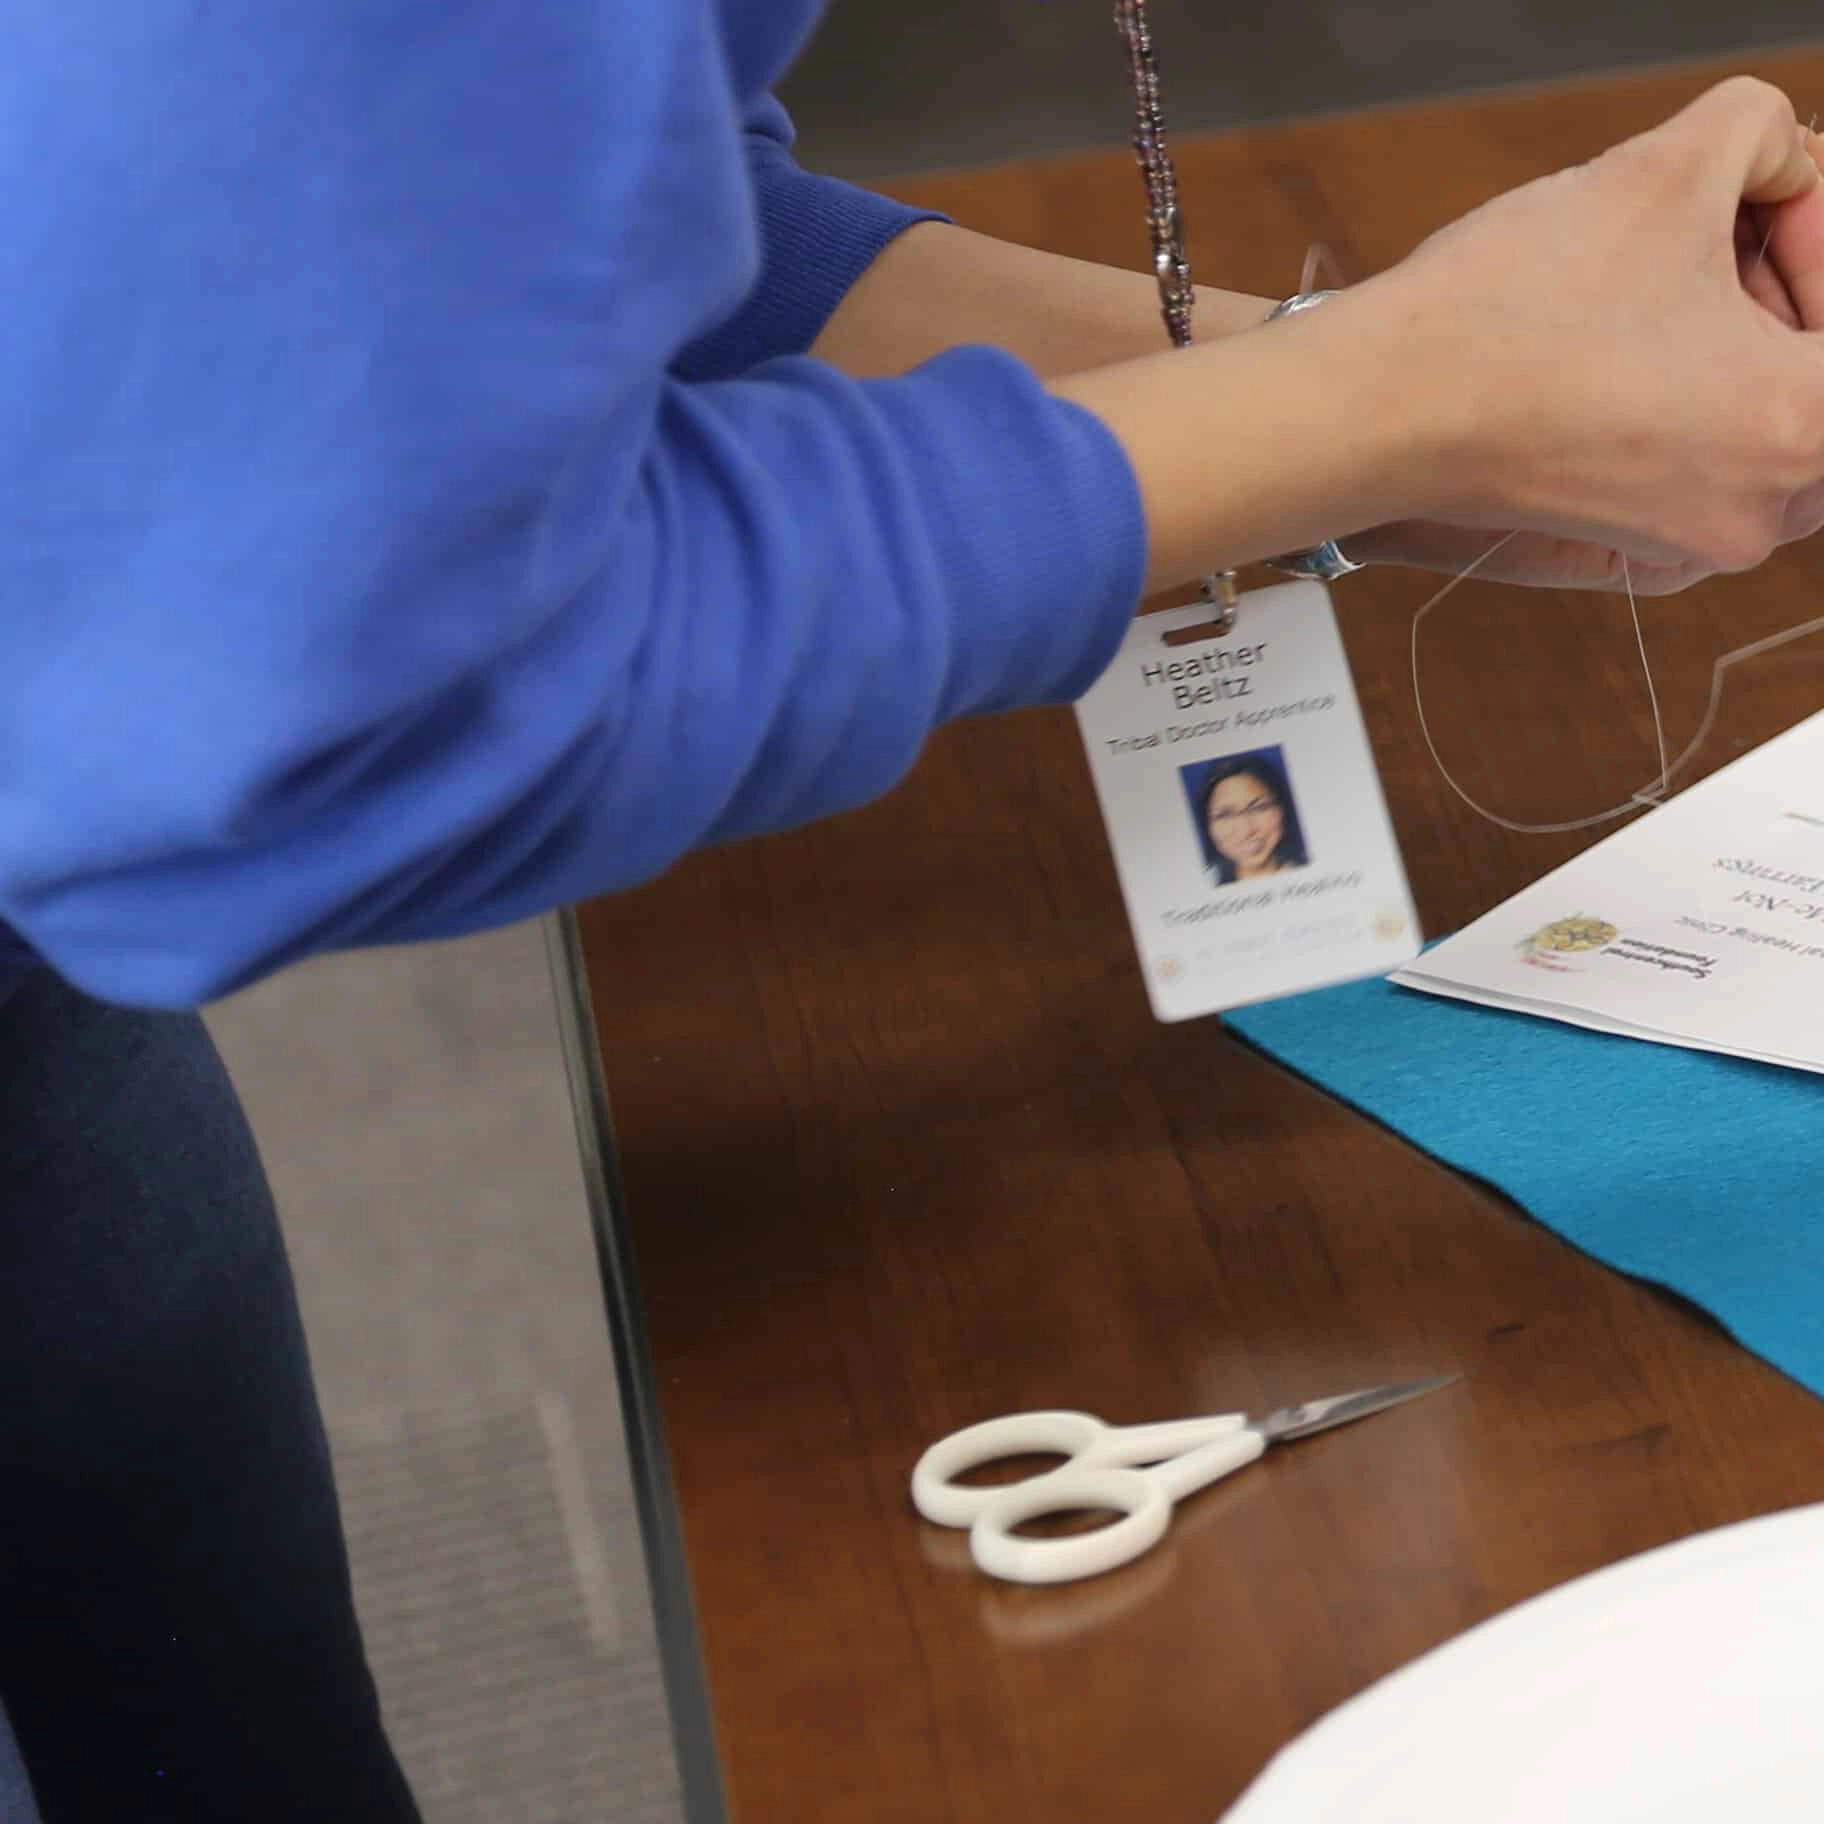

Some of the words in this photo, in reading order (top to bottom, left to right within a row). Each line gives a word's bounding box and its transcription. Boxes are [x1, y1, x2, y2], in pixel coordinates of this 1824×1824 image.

[1140, 641, 1268, 686] Heather
[1105, 727, 1163, 756] Tribal
[1167, 716, 1231, 745] Doctor
[1711, 855, 1822, 897] Earrings
[1671, 914, 1727, 936] Clinic
[1725, 921, 1801, 956] Healing
[1598, 946, 1712, 979] Southcentral
[1619, 937, 1717, 967] Foundation
